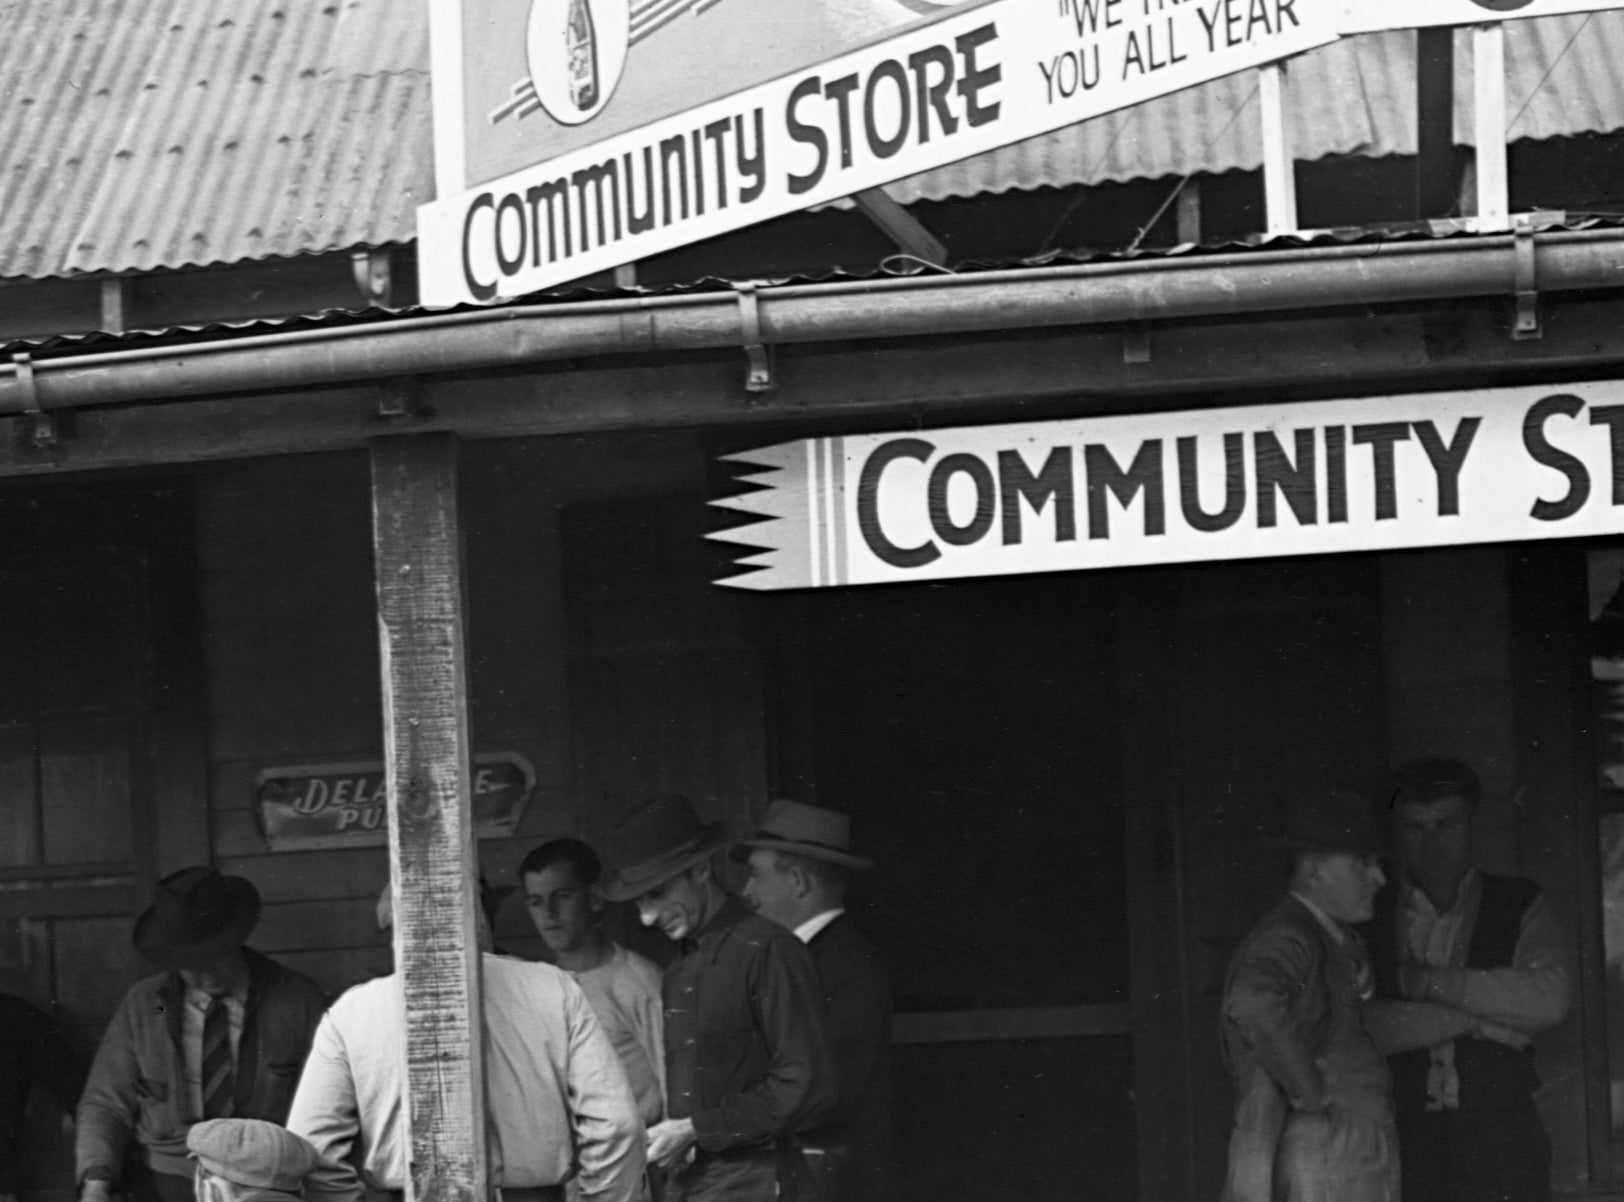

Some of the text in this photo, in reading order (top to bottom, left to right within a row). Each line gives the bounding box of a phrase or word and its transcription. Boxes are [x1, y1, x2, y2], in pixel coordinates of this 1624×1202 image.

[786, 21, 1003, 195] STORE
[1038, 0, 1300, 104] YOU ALL YEAR
[856, 415, 1483, 569] COMMUNITY
